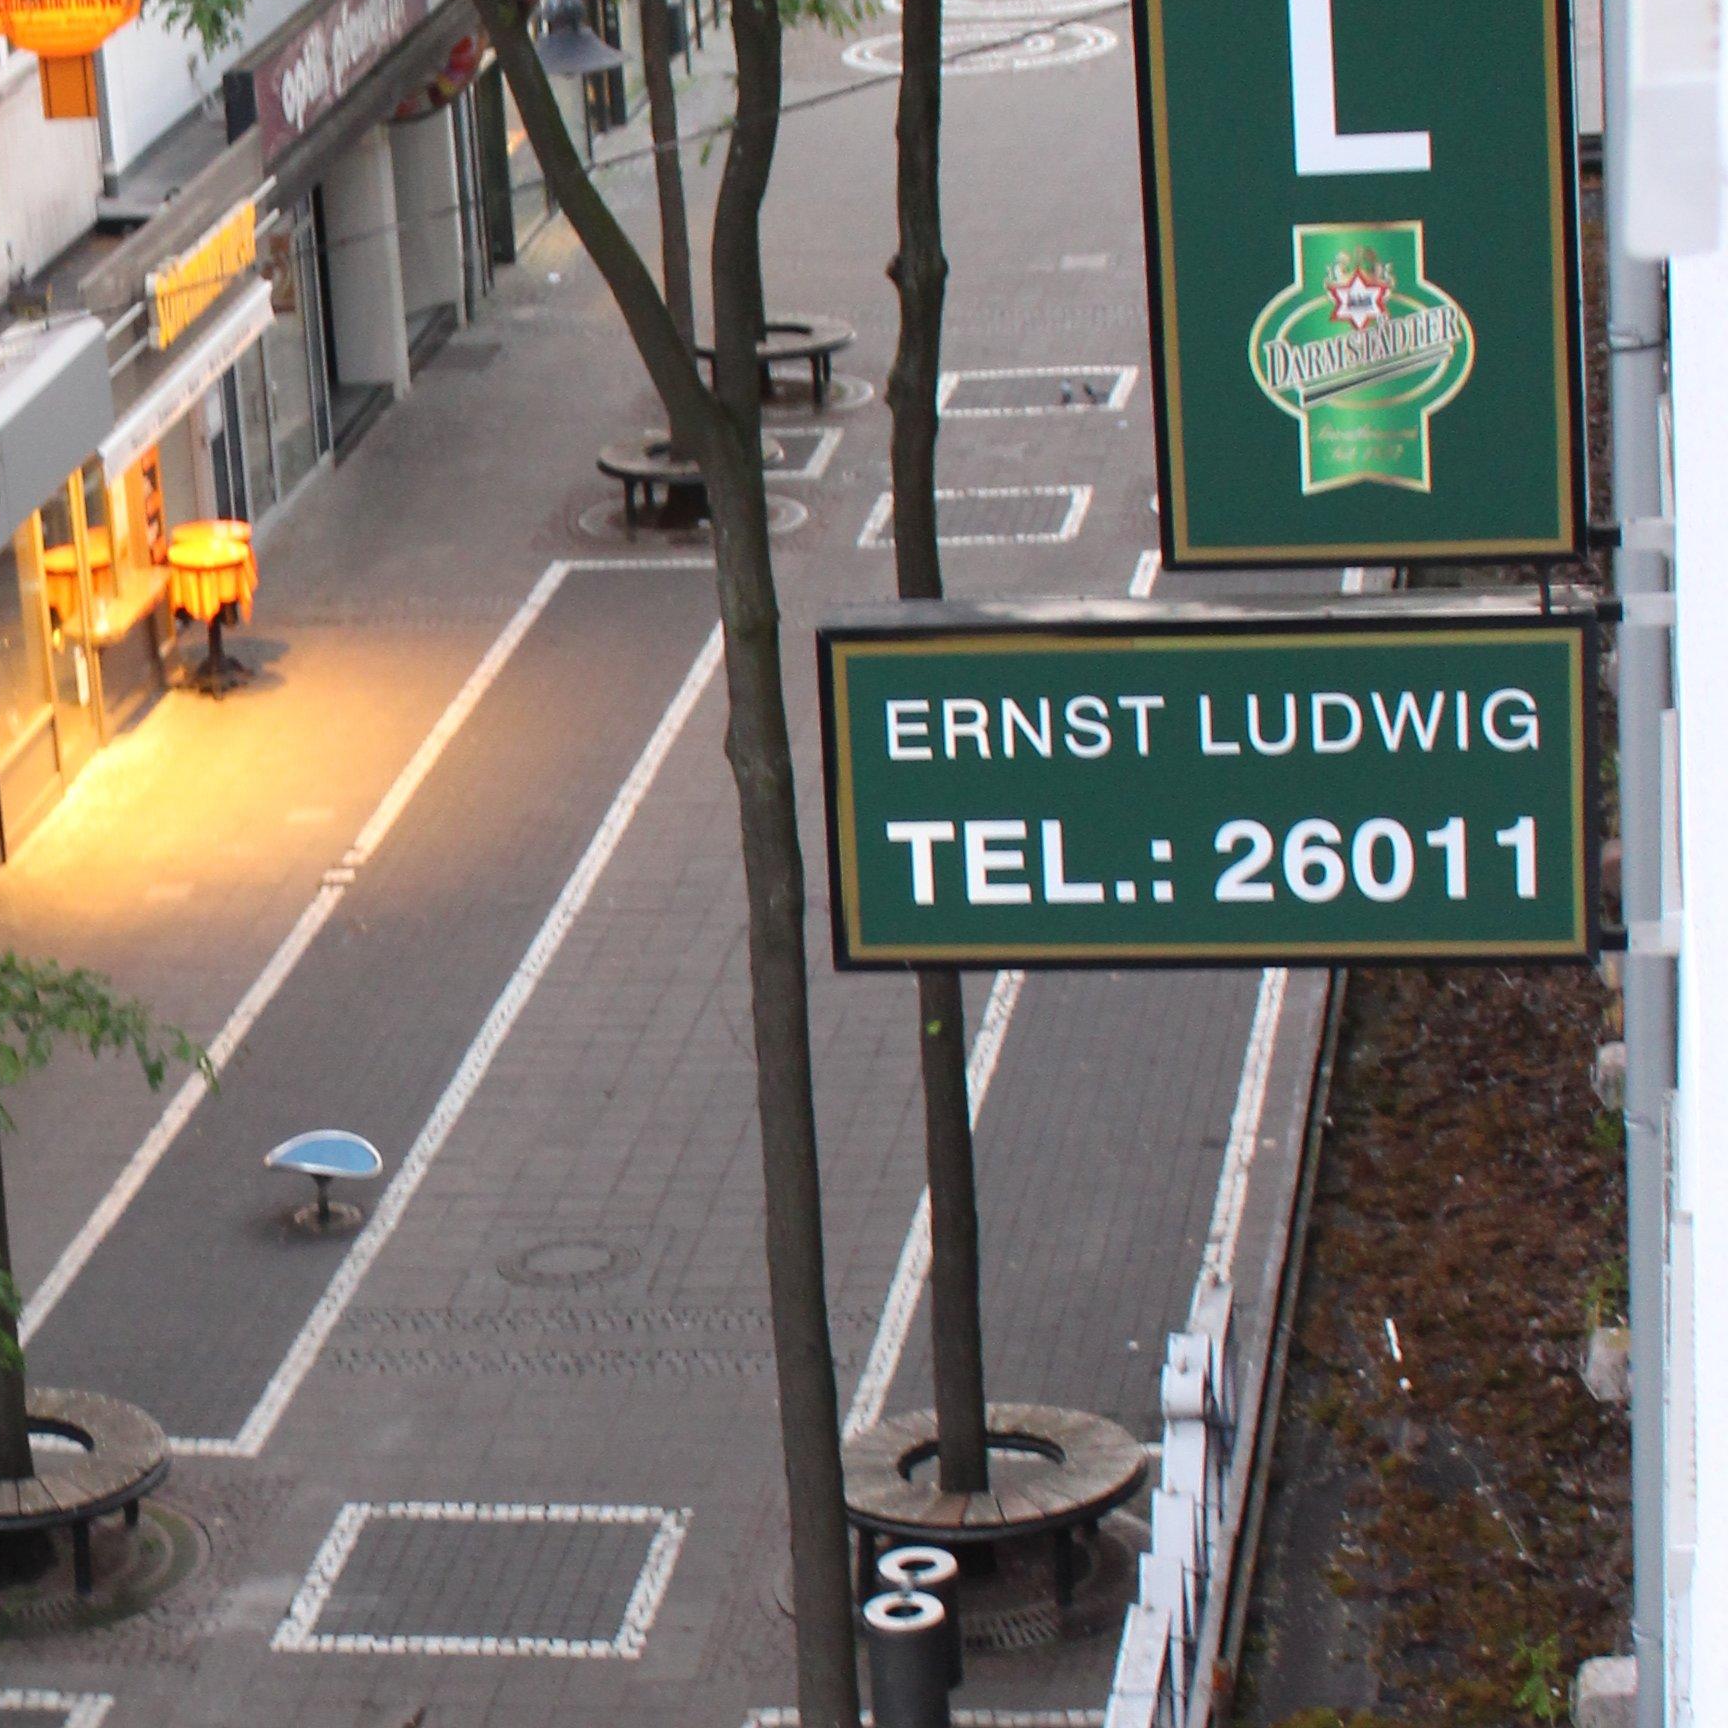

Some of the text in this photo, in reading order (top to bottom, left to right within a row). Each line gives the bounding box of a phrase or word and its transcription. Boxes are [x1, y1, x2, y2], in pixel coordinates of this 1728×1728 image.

[1263, 304, 1462, 389] DARMSTÄDTER
[885, 687, 1540, 761] ERNST LUDWIG
[886, 816, 1538, 906] TEL.: 26011
